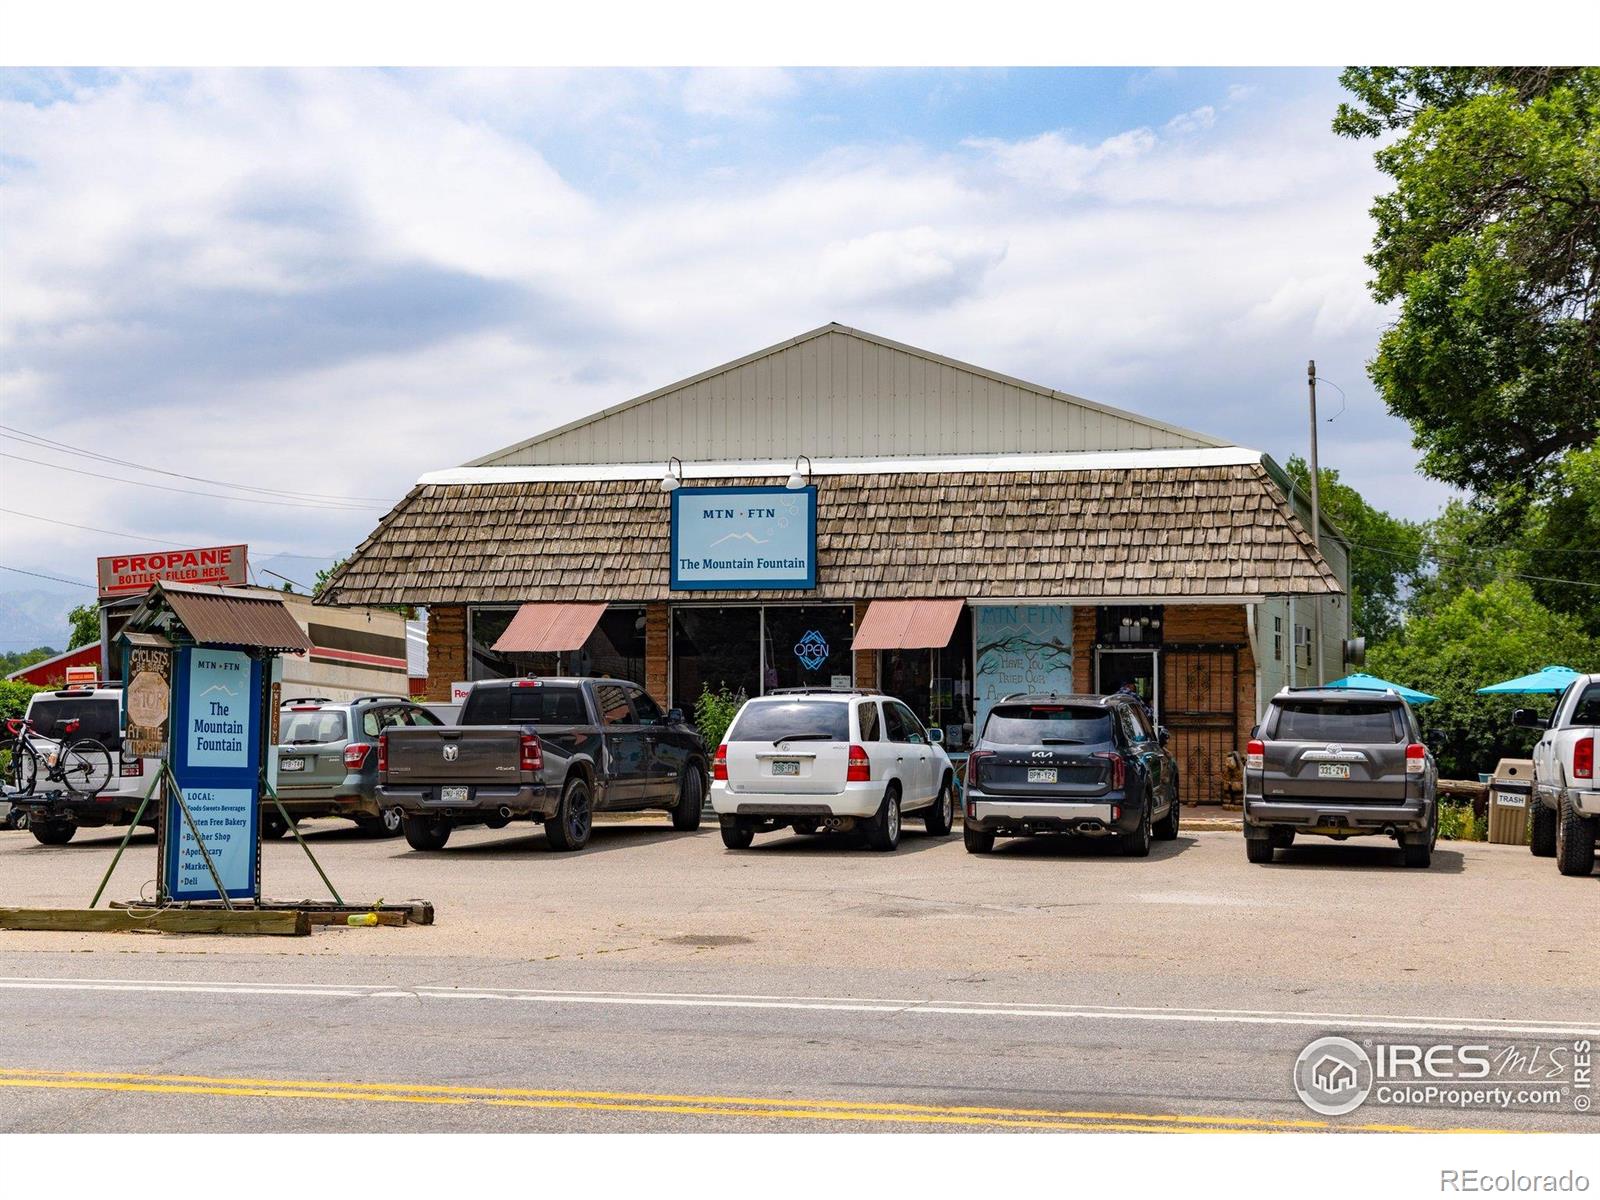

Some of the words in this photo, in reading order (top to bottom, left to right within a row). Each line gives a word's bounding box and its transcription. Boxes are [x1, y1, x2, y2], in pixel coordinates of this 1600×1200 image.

[703, 509, 734, 519] MTN
[748, 508, 775, 518] FTN
[112, 549, 232, 574] PROPANE
[679, 558, 700, 570] The
[702, 558, 754, 569] Mountain
[757, 557, 805, 569] Fountain
[118, 572, 161, 585] BOTTLES
[166, 568, 198, 581] FILLED
[202, 566, 226, 577] HERE
[794, 643, 829, 657] OPEN
[198, 661, 217, 669] MTN
[224, 662, 240, 671] FTN
[210, 701, 229, 716] The
[128, 724, 139, 738] AT
[145, 726, 163, 740] THE
[194, 719, 243, 734] Mountain
[197, 737, 242, 752] Fountain
[187, 792, 215, 801] LOCAL:
[1499, 795, 1524, 804] TRASH
[210, 818, 224, 826] Free
[225, 818, 247, 827] Bakery
[214, 832, 231, 842] Shop
[184, 877, 198, 886] Deli
